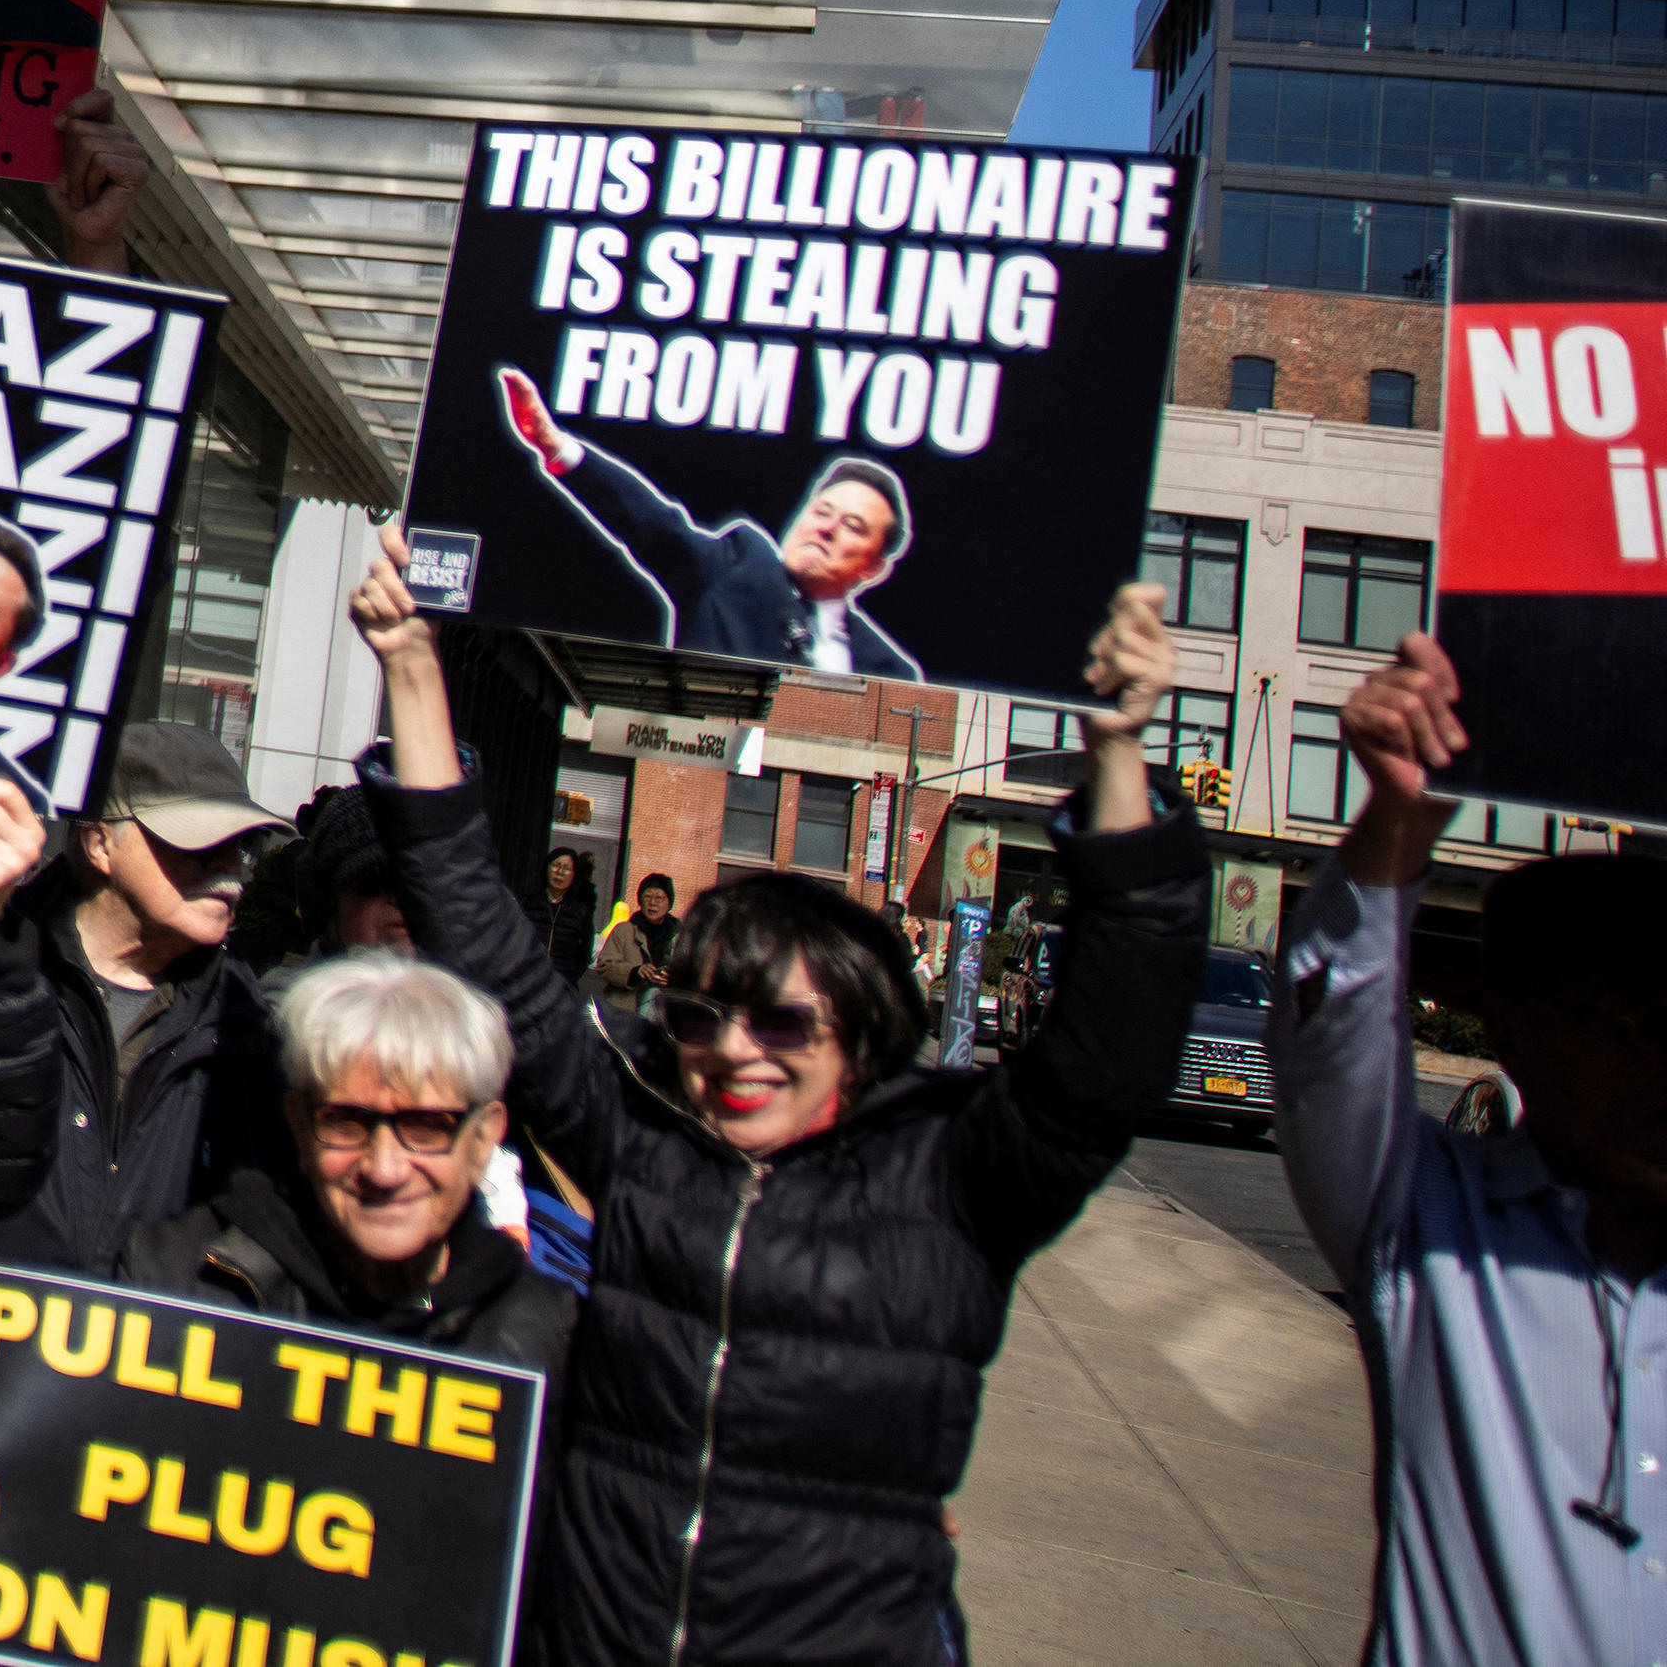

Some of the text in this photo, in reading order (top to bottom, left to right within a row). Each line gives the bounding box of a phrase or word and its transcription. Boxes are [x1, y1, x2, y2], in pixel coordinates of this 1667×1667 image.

[486, 132, 1175, 252] THIS BILLIONAIRE
[536, 225, 1058, 350] IS STEALING
[553, 326, 1001, 455] FROM YOU
[1466, 326, 1638, 438] NO
[411, 548, 470, 570] RISE AND
[1607, 447, 1667, 562] i
[408, 563, 468, 589] RESIST
[626, 734, 725, 759] FURSTENBERG
[627, 723, 726, 749] DIANE VON
[276, 1340, 503, 1463] THE
[75, 1442, 376, 1579] PLUG
[139, 1595, 479, 1667] MU
